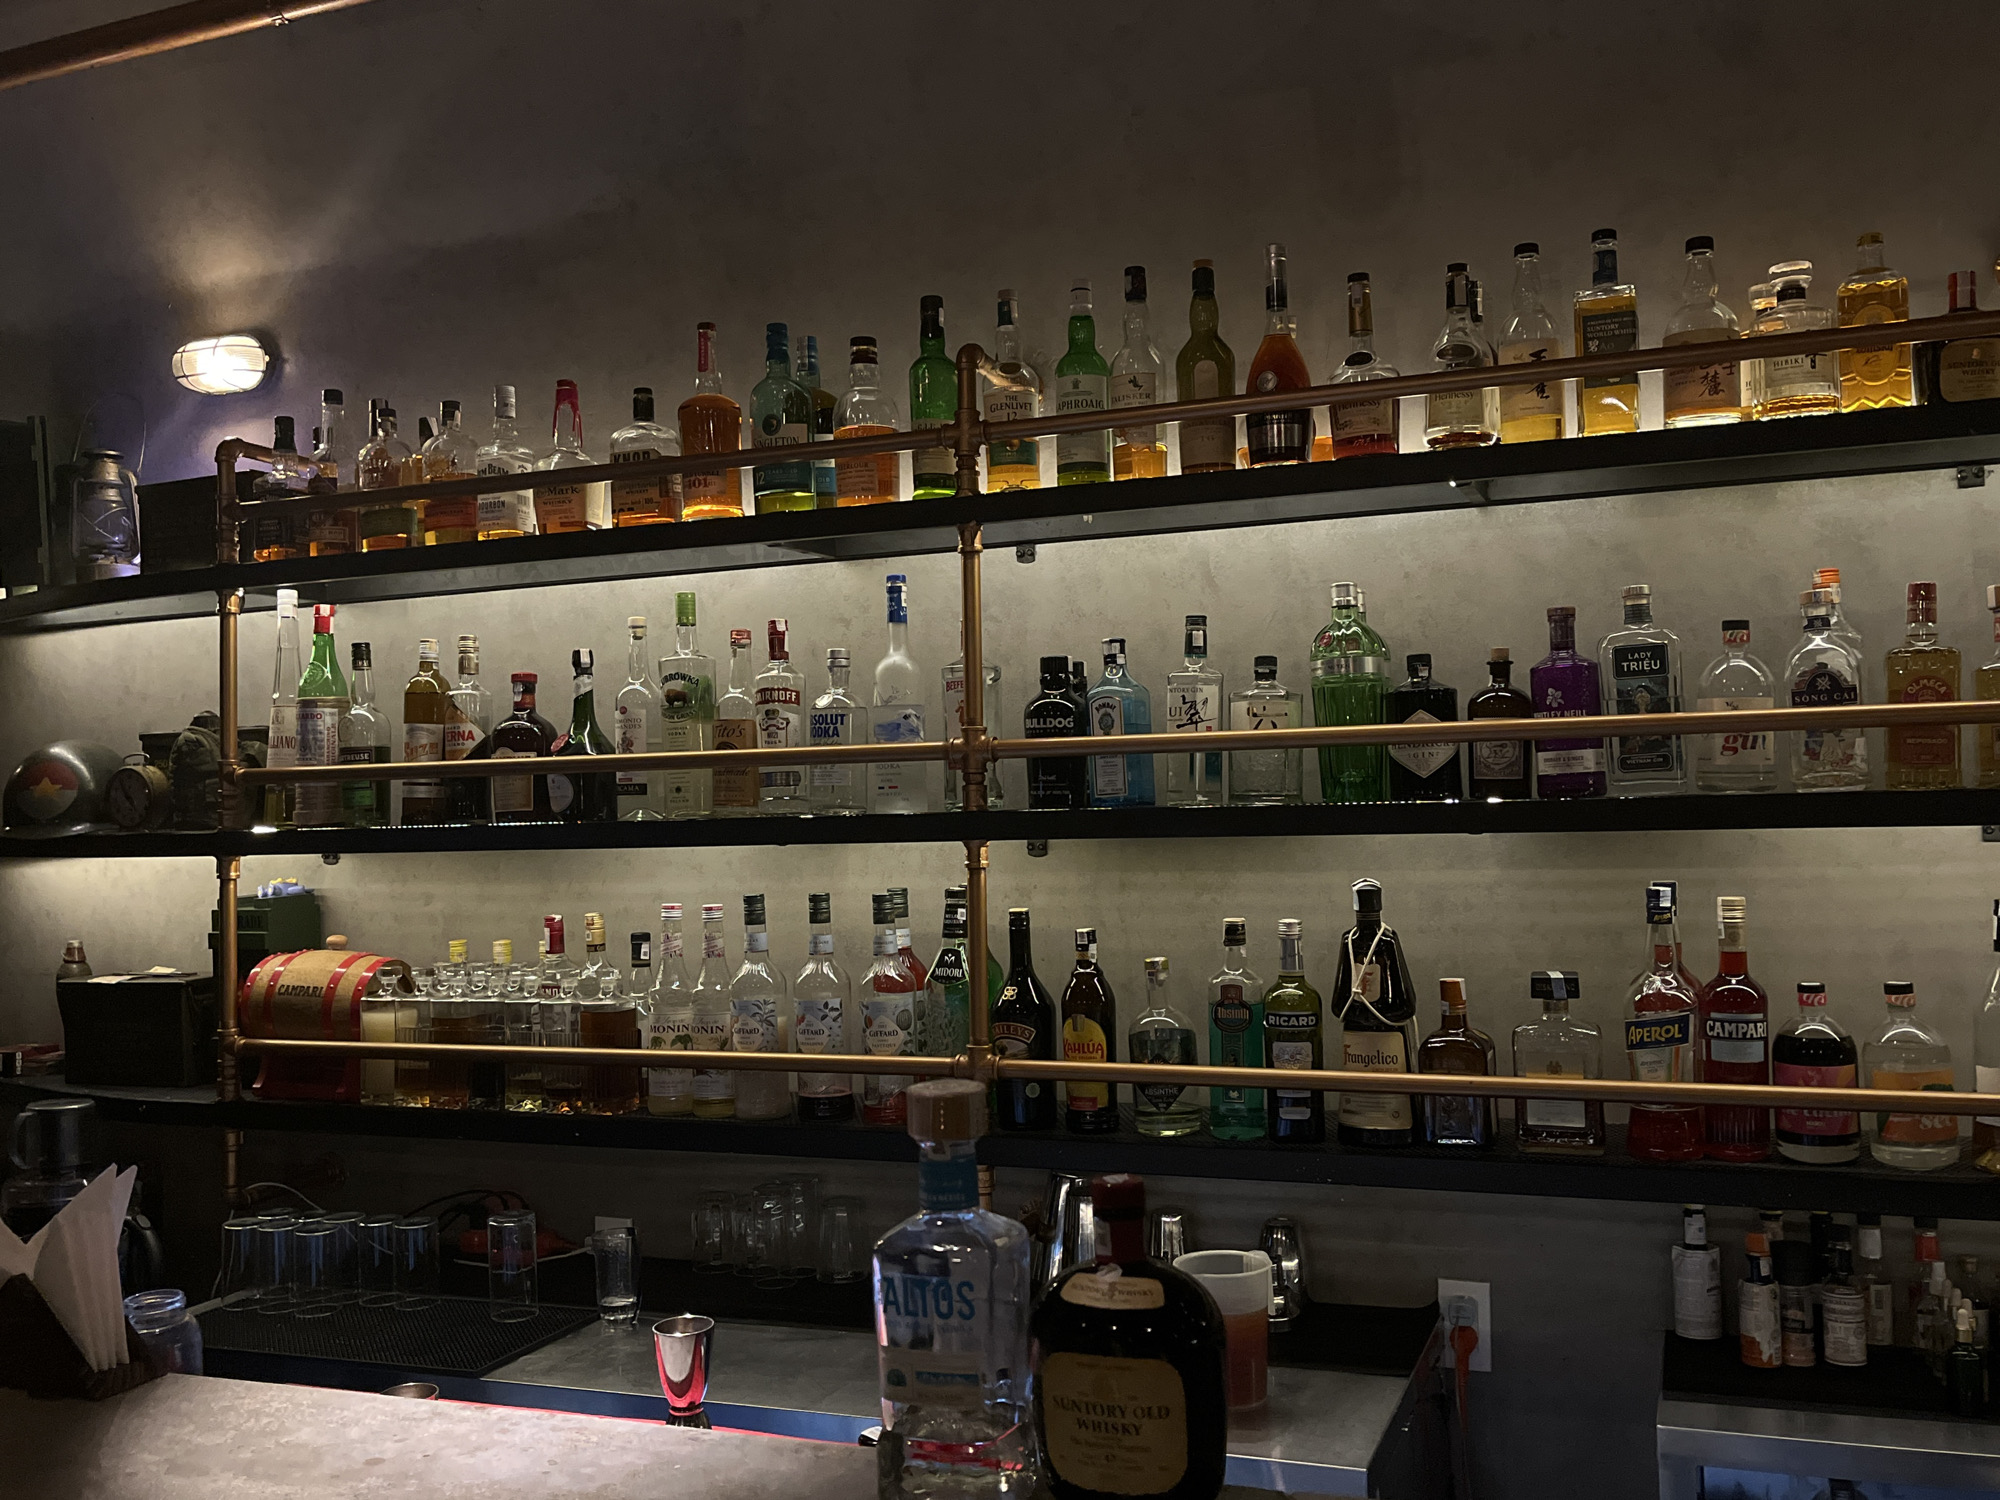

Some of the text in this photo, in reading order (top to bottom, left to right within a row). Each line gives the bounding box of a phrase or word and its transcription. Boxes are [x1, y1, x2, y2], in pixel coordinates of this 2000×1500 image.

[1587, 324, 1619, 332] SUNTORY
[1614, 328, 1637, 336] WHIS
[1773, 359, 1805, 369] HIBIKI
[1434, 391, 1475, 402] Hennessy
[990, 402, 1032, 413] GLENLIVET
[1056, 399, 1106, 411] APHROAIG
[1337, 400, 1386, 413] Hennessy
[1007, 411, 1018, 420] 12
[752, 437, 800, 448] SINGLETON
[488, 463, 509, 475] BEAM
[755, 472, 765, 484] 12
[548, 485, 579, 495] Mark
[687, 479, 711, 490] 101
[1628, 651, 1652, 660] LADY
[1621, 658, 1661, 673] TRIỆU
[1906, 679, 1949, 695] OLMECA
[756, 690, 797, 702] MIRNOFF
[1095, 703, 1116, 713] BOMBAY
[1169, 707, 1184, 718] UI
[810, 713, 847, 726] BSOLUT
[1026, 717, 1074, 729] BULLDOG
[447, 730, 476, 742] ERNA
[714, 722, 747, 738] Tito's
[810, 726, 840, 738] ODKA
[1720, 734, 1767, 757] gin
[934, 967, 964, 978] MIDORI
[277, 984, 325, 998] CAMPARI
[1268, 1015, 1317, 1027] RICARD
[650, 1024, 691, 1034] MONIN
[691, 1025, 725, 1035] ONIN
[868, 1030, 899, 1038] GIFFARD
[1627, 1023, 1683, 1045] APEROL
[1706, 1020, 1767, 1038] CAMPARI
[1063, 1039, 1104, 1059] KAHLÚA
[1342, 1044, 1398, 1067] Frangelico
[1145, 1087, 1179, 1096] ABSINTHE
[882, 1275, 977, 1320] ALTOS
[1052, 1395, 1171, 1421] SUNTORY OLD
[1075, 1417, 1144, 1437] WHISKY
